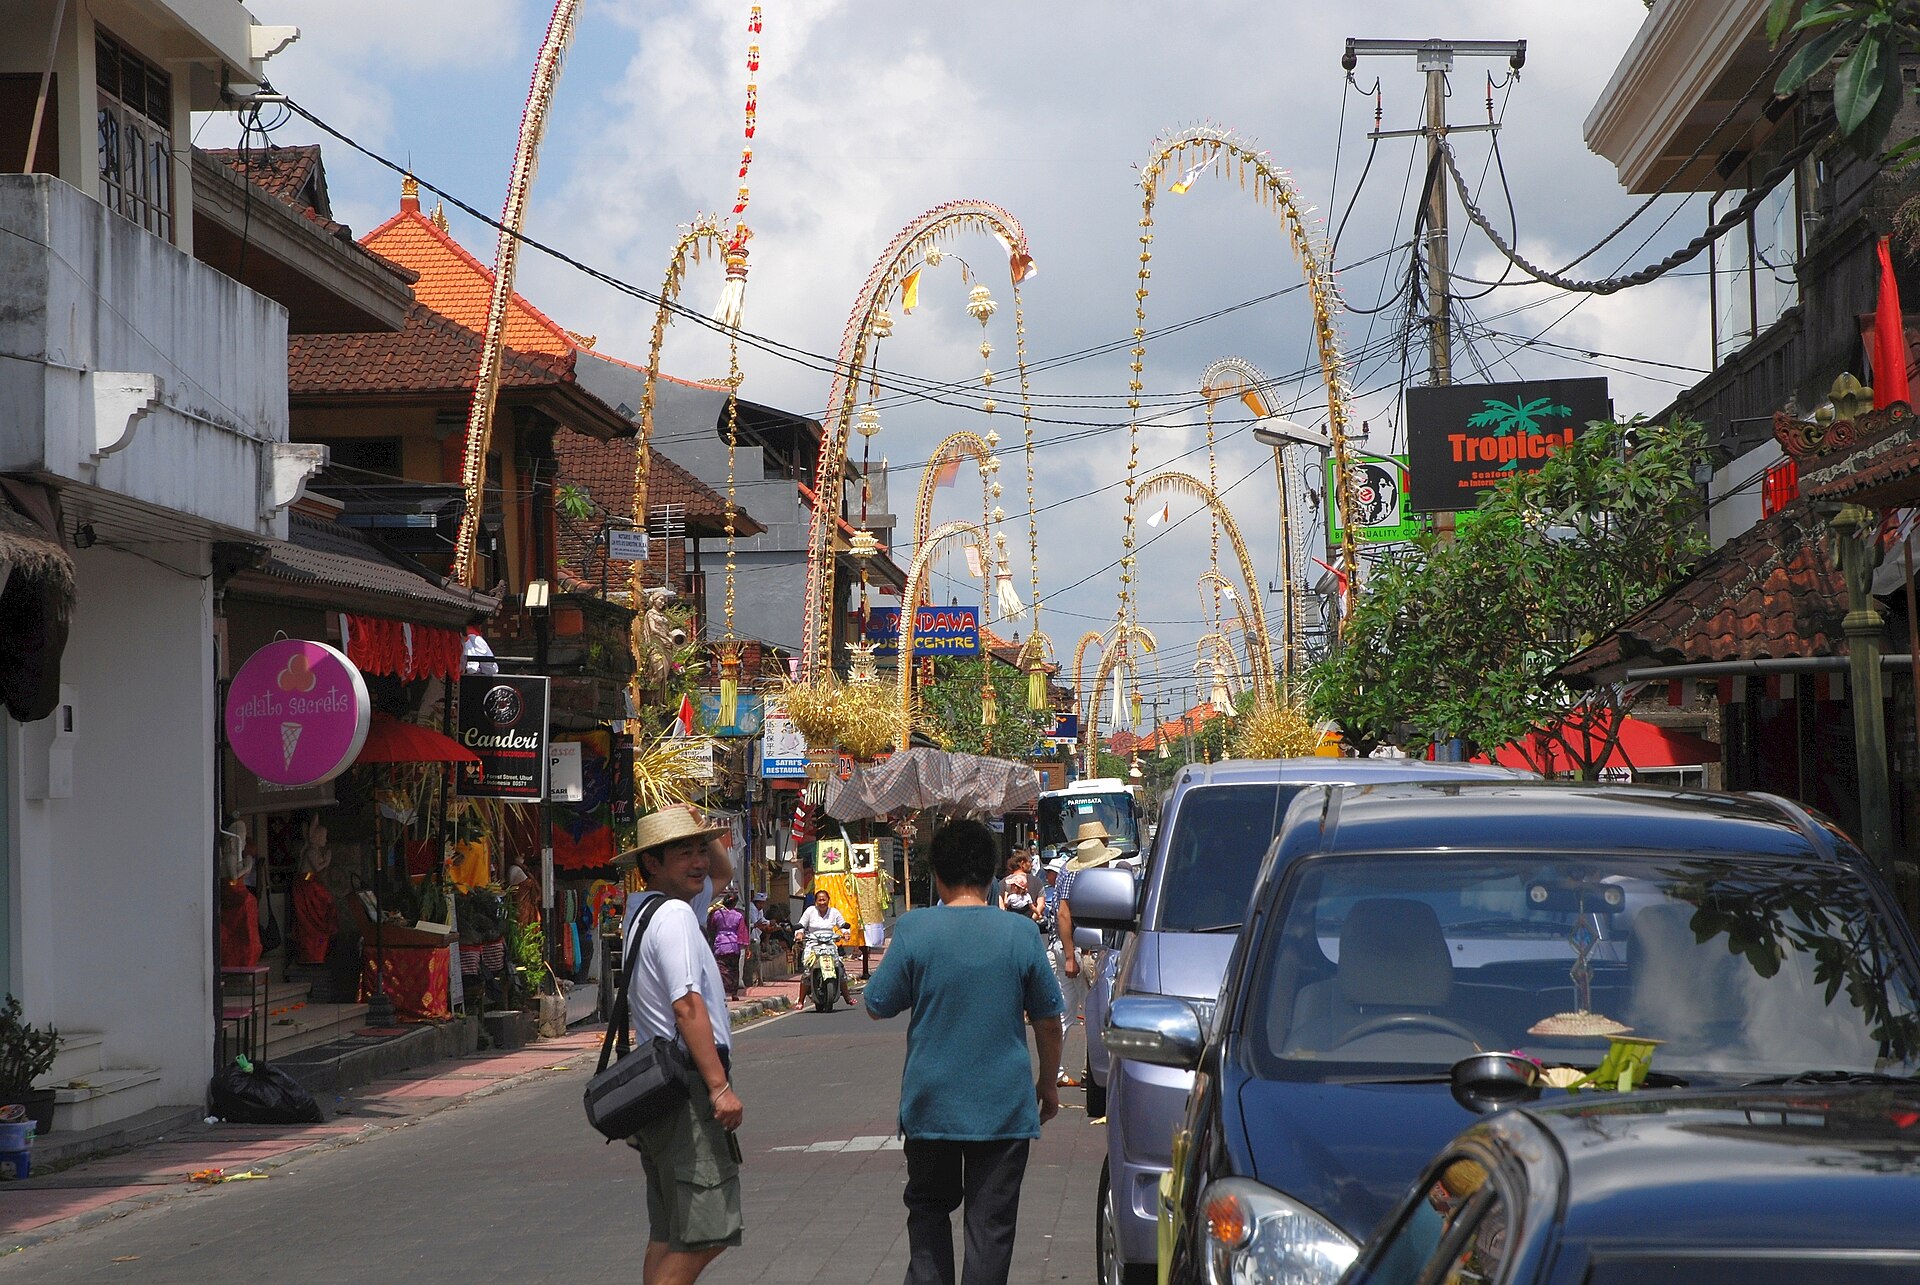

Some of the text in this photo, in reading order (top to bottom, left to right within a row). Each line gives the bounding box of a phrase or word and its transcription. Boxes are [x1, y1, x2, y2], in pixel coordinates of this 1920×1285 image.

[914, 636, 975, 649] CENTRE
[234, 685, 348, 733] gelato secrets
[464, 727, 539, 749] Canderi
